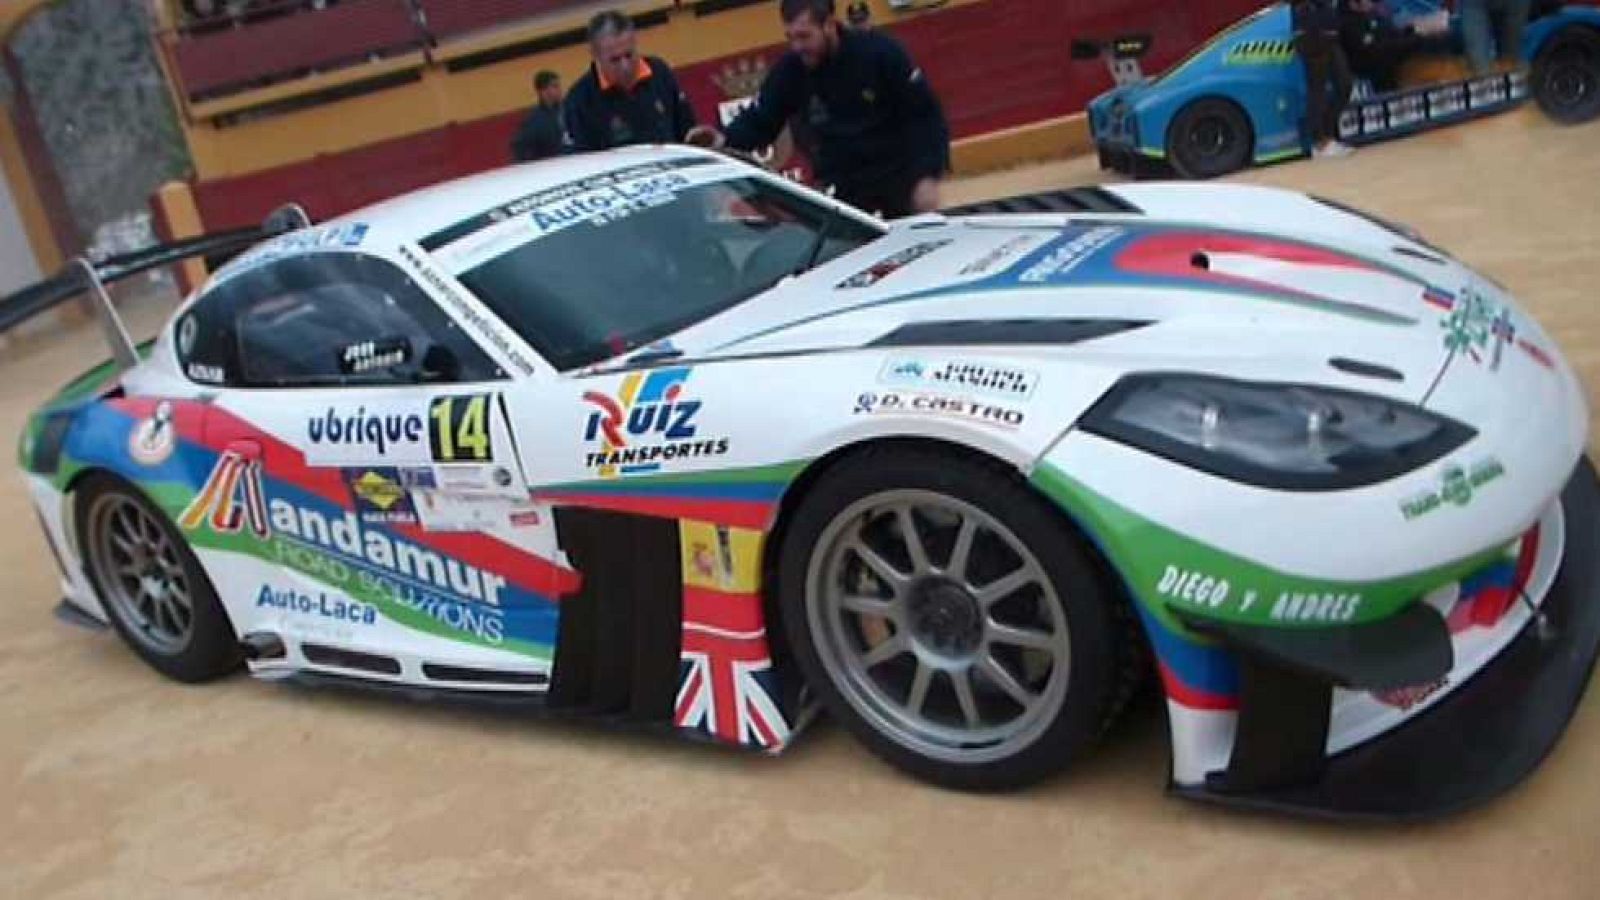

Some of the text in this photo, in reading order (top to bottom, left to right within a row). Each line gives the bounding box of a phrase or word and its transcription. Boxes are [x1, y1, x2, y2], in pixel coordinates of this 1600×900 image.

[531, 173, 690, 231] Auto-Laca
[307, 404, 424, 454] ubrique
[431, 396, 489, 460] 14
[912, 395, 1024, 425] CASTRO
[585, 438, 730, 468] TRANSPORTES
[257, 583, 377, 626] Auto-Laca
[273, 538, 504, 643] ROAD SOLUTIONS
[1157, 564, 1230, 608] DIEGO
[1269, 593, 1361, 621] ANDRES
